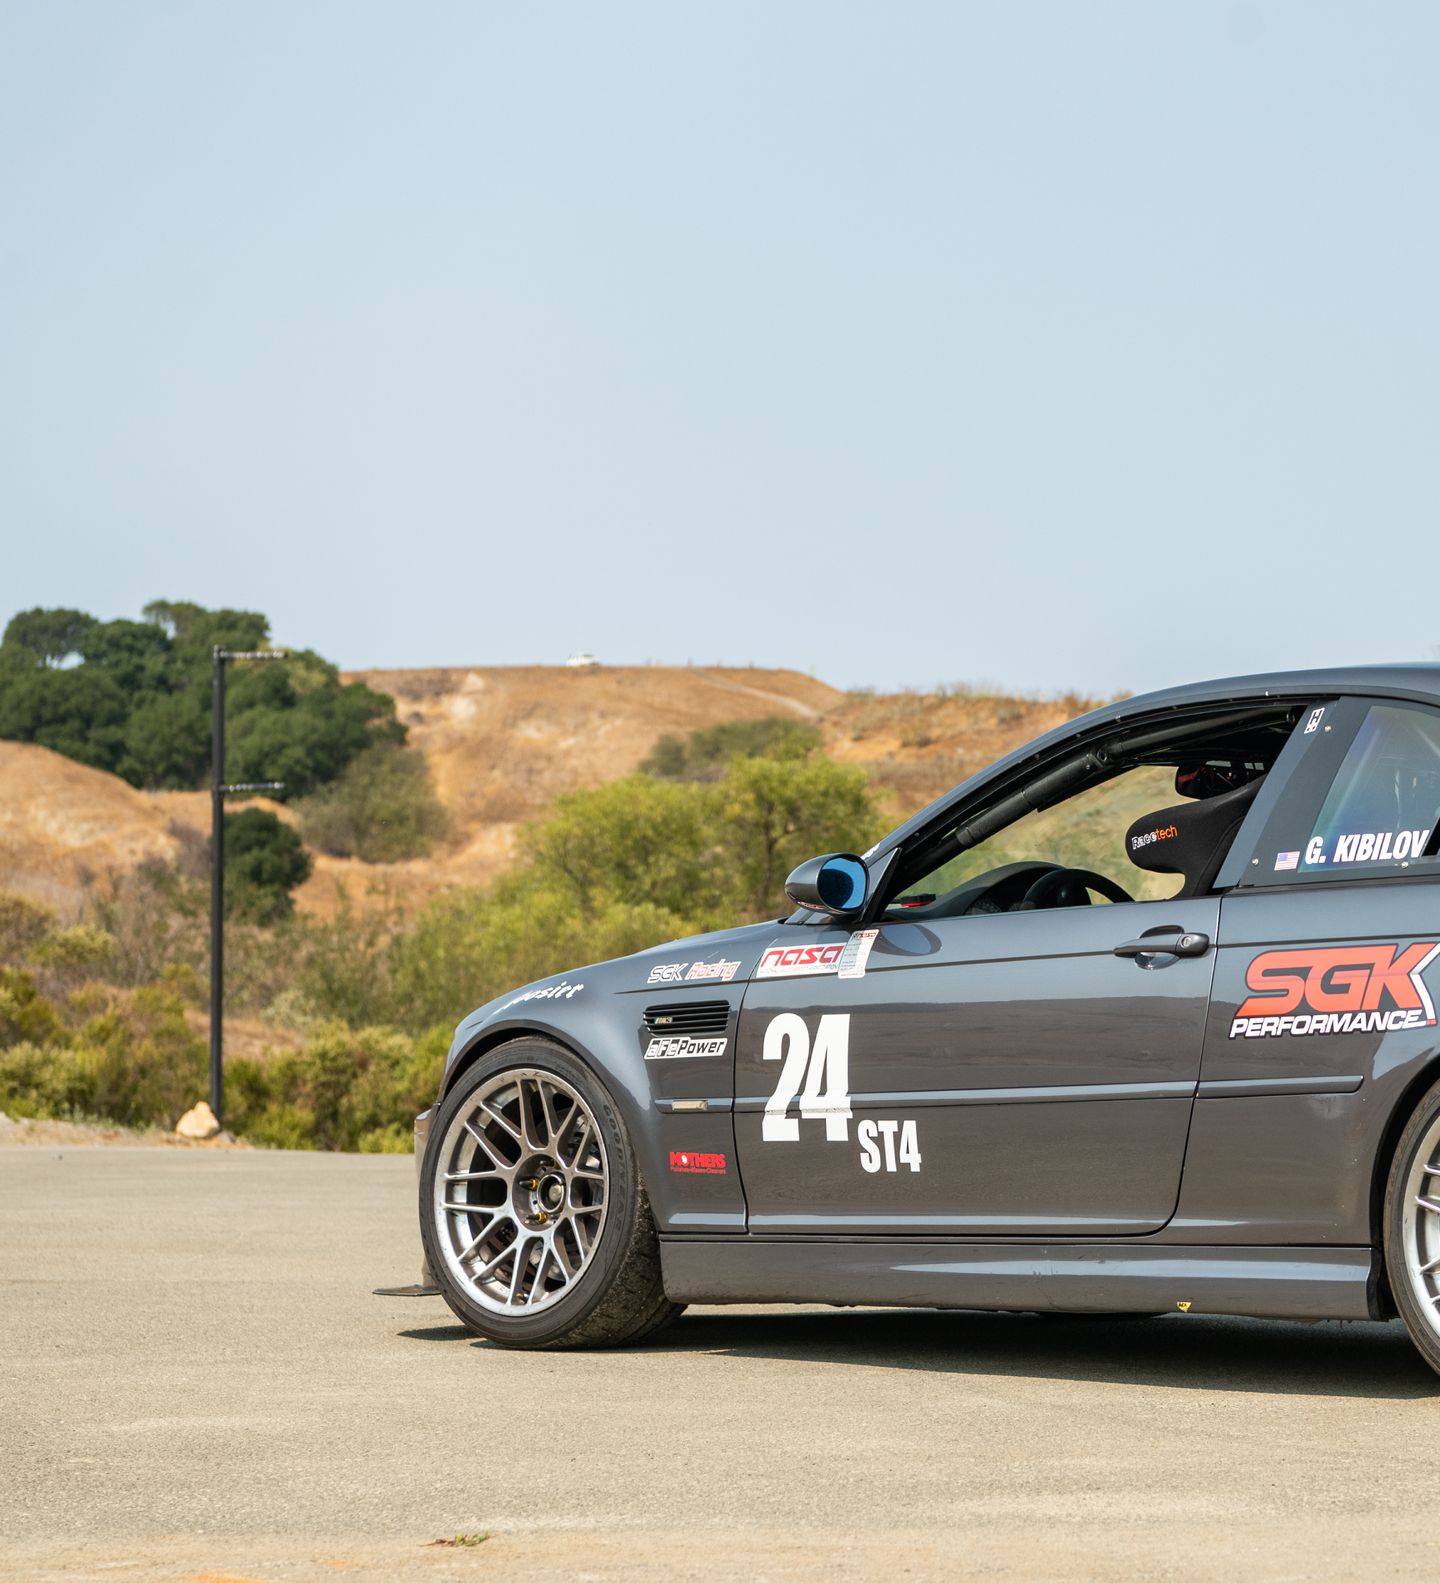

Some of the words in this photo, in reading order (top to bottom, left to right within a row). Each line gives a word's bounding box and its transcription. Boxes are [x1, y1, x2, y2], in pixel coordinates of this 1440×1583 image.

[1131, 825, 1178, 850] Racetech
[1304, 836, 1327, 865] G.
[1333, 829, 1430, 863] KIBILOV
[760, 945, 845, 968] nasa
[647, 963, 688, 983] SGK
[685, 959, 742, 982] Racing
[1229, 1008, 1427, 1039] PERFORMANCE
[762, 1012, 853, 1142] 24
[857, 1119, 923, 1173] ST4
[669, 1152, 727, 1169] MOTHERS
